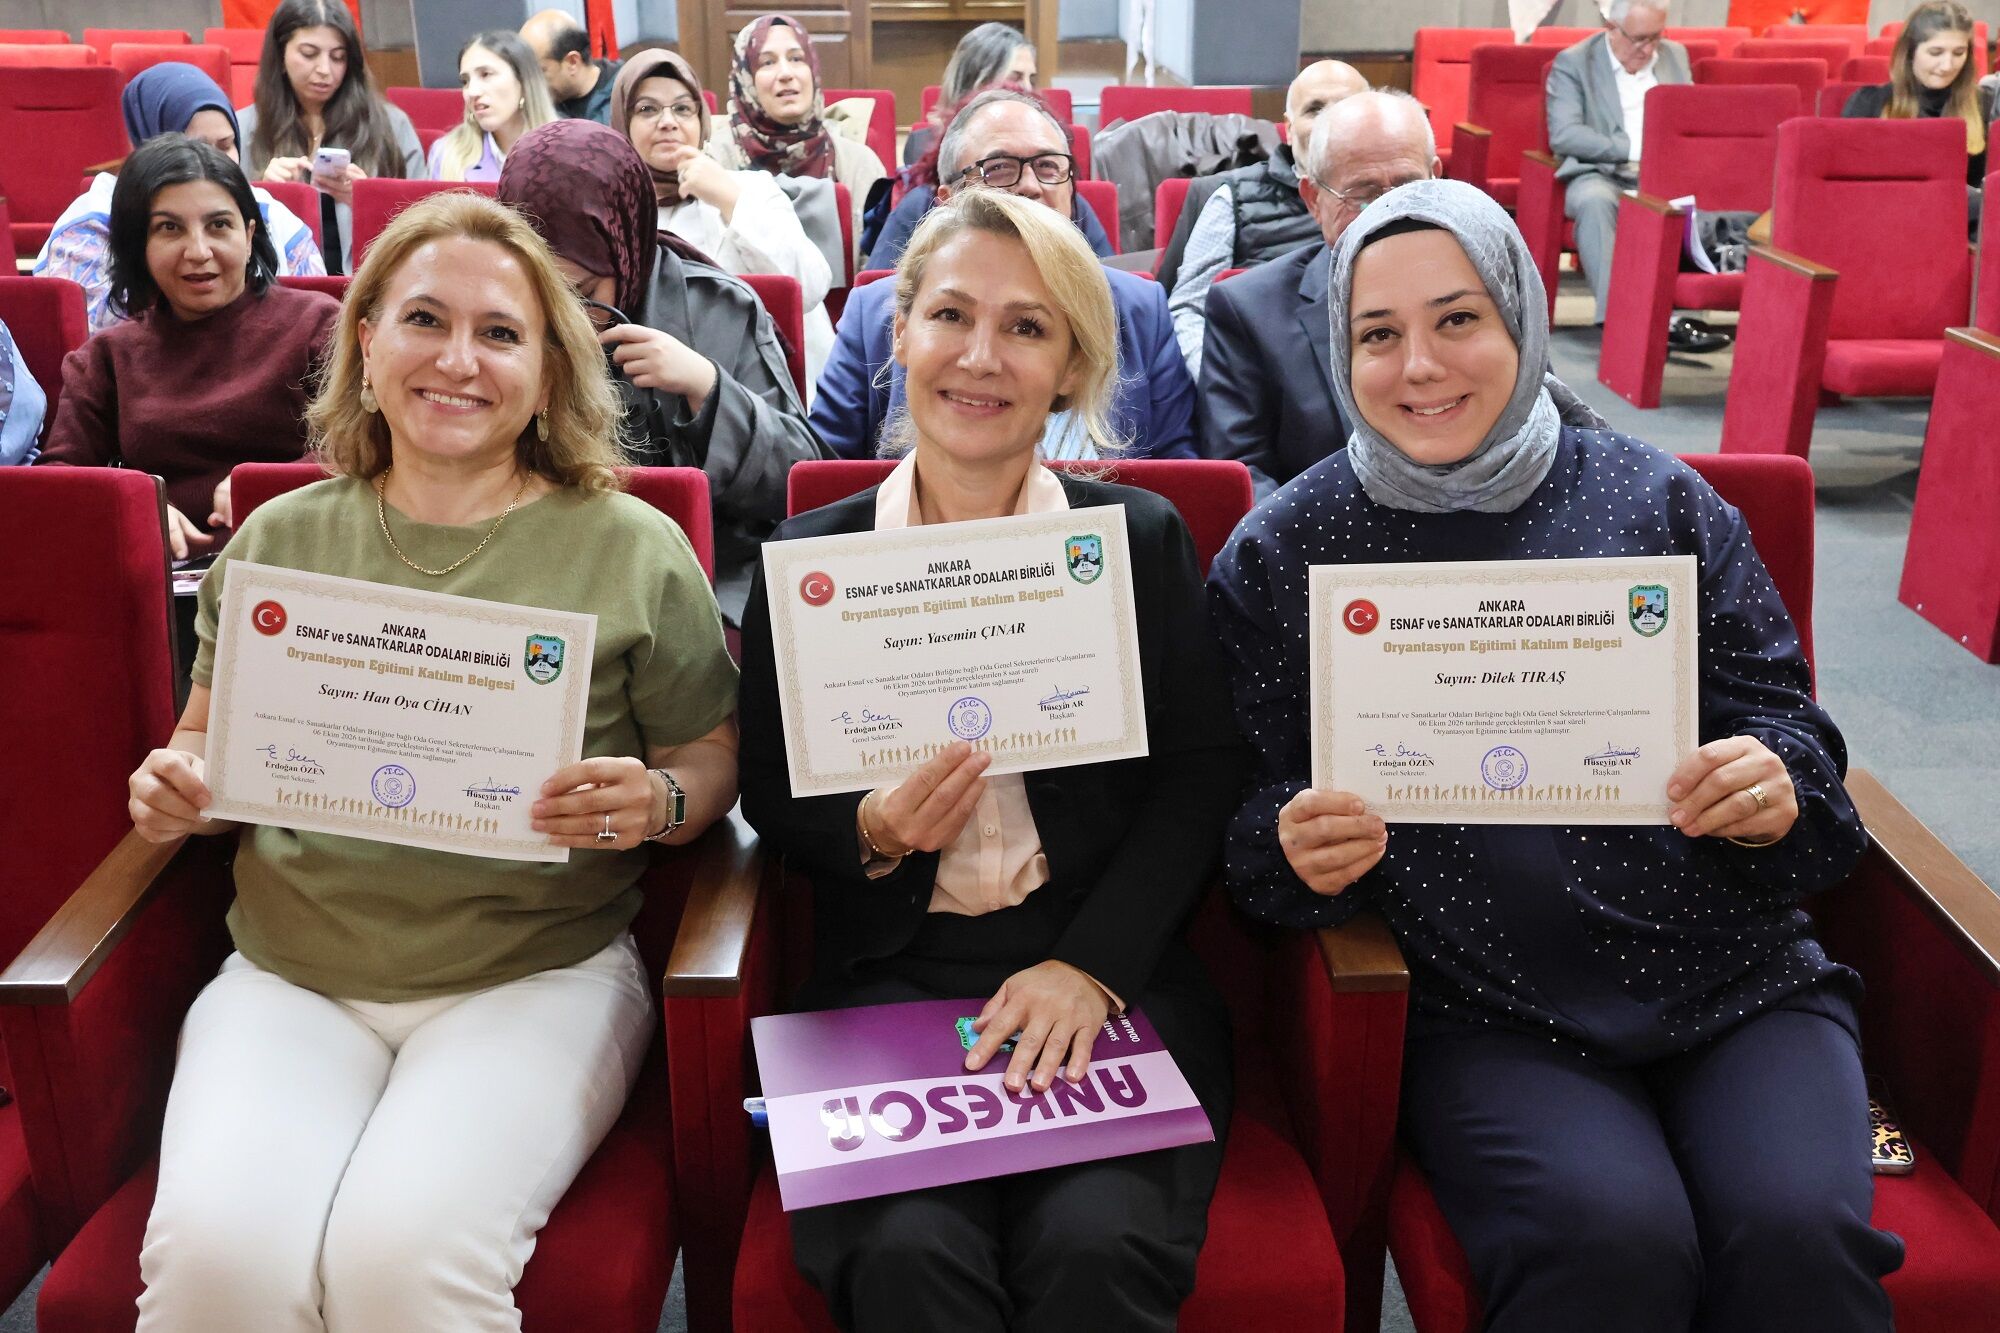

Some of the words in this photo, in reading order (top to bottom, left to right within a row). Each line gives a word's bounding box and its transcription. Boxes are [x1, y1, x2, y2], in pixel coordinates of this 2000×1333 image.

[928, 559, 971, 574] ANKARA
[846, 585, 878, 599] ESNAF
[881, 584, 893, 594] ve
[896, 575, 970, 594] SANATKARLAR
[974, 570, 1018, 584] ODALARI
[1020, 562, 1055, 579] BİRLİĞİ
[842, 605, 919, 622] Oryantasyon
[923, 598, 967, 614] Eğitimi
[970, 593, 1015, 608] Katılım
[1018, 587, 1064, 602] Belgesi
[1479, 600, 1525, 612] ANKARA
[1390, 618, 1424, 630] ESNAF
[1427, 618, 1440, 629] ve
[1443, 616, 1523, 629] SANATKARLAR
[1526, 615, 1574, 627] ODALARI
[1577, 611, 1615, 626] BİRLİĞİ
[382, 623, 426, 640] ANKARA
[884, 637, 922, 650] Sayın:
[928, 629, 976, 644] Yasemin
[981, 622, 1026, 640] ÇINAR
[296, 625, 330, 640] ESNAF
[332, 632, 344, 642] ve
[346, 633, 424, 656] SANATKARLAR
[426, 646, 472, 662] ODALARI
[474, 650, 510, 668] BİRLİĞİ
[1383, 642, 1465, 655] Oryantasyon
[1470, 640, 1516, 654] Eğitimi
[1521, 638, 1568, 650] Katılım
[1573, 637, 1622, 651] Belgesi
[286, 647, 365, 668] Oryantasyon
[369, 659, 414, 676] Eğitimi
[418, 666, 464, 683] Katılım
[468, 674, 515, 690] Belgesi
[1435, 672, 1477, 687] Sayın:
[1481, 672, 1516, 684] Dilek
[1521, 671, 1566, 684] TIRAŞ
[318, 684, 358, 700] Sayın:
[362, 690, 390, 704] Han
[394, 696, 420, 709] Oya
[424, 698, 472, 716] CİHAN
[1040, 702, 1070, 712] Hüseyin
[1072, 700, 1084, 708] AR
[844, 726, 876, 735] Erdoğan
[878, 721, 903, 732] ÖZEN
[265, 761, 298, 772] Erdoğan
[300, 764, 325, 775] ÖZEN
[1373, 760, 1406, 768] Erdoğan
[1409, 758, 1435, 767] ÖZEN
[1584, 759, 1617, 767] Hüseyin
[466, 790, 497, 800] Hüseyin
[499, 794, 511, 802] AR
[821, 1064, 1148, 1151] ANKESOB
